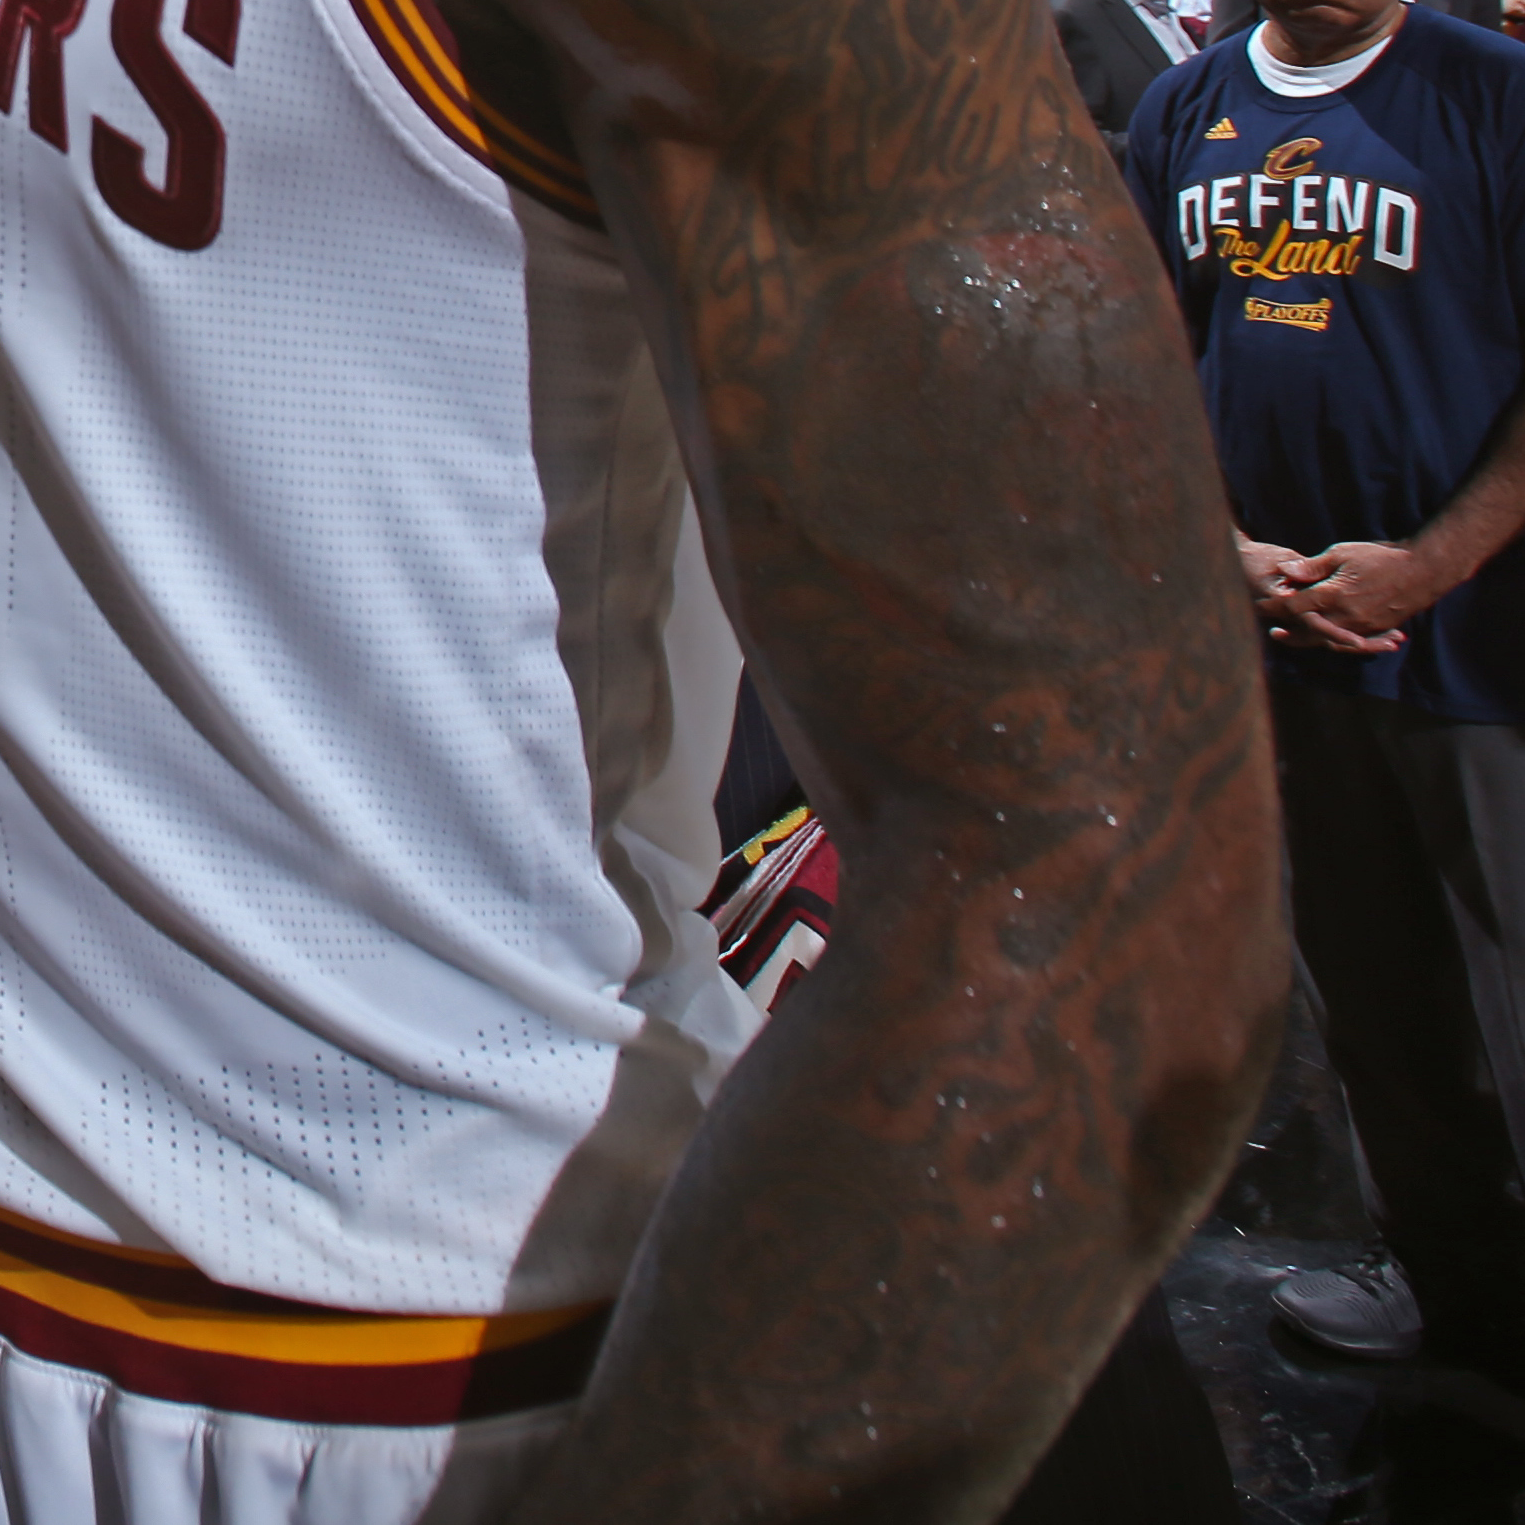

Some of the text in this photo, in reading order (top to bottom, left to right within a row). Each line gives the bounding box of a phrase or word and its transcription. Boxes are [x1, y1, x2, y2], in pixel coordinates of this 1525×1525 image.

[1178, 173, 1420, 272] DEFEND
[1213, 218, 1366, 282] The Land
[1255, 305, 1330, 323] PLAYOFFS
